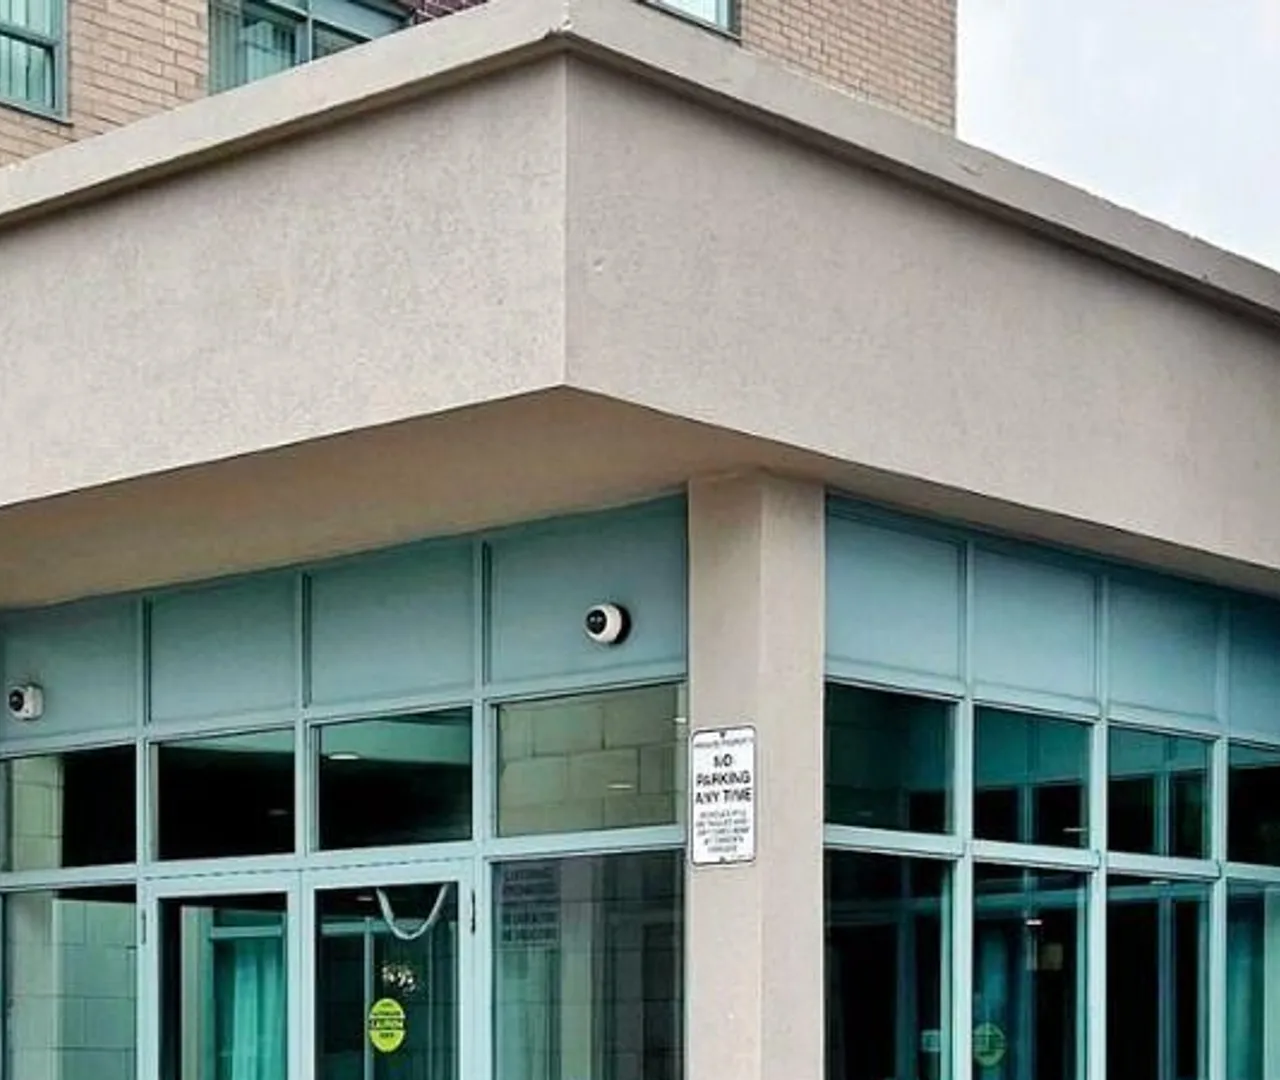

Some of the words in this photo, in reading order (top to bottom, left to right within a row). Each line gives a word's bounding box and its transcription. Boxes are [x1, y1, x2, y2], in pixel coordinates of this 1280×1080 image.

[713, 753, 733, 768] NO
[696, 770, 751, 786] PARKING
[696, 791, 719, 804] ANY
[723, 787, 751, 802] TIME
